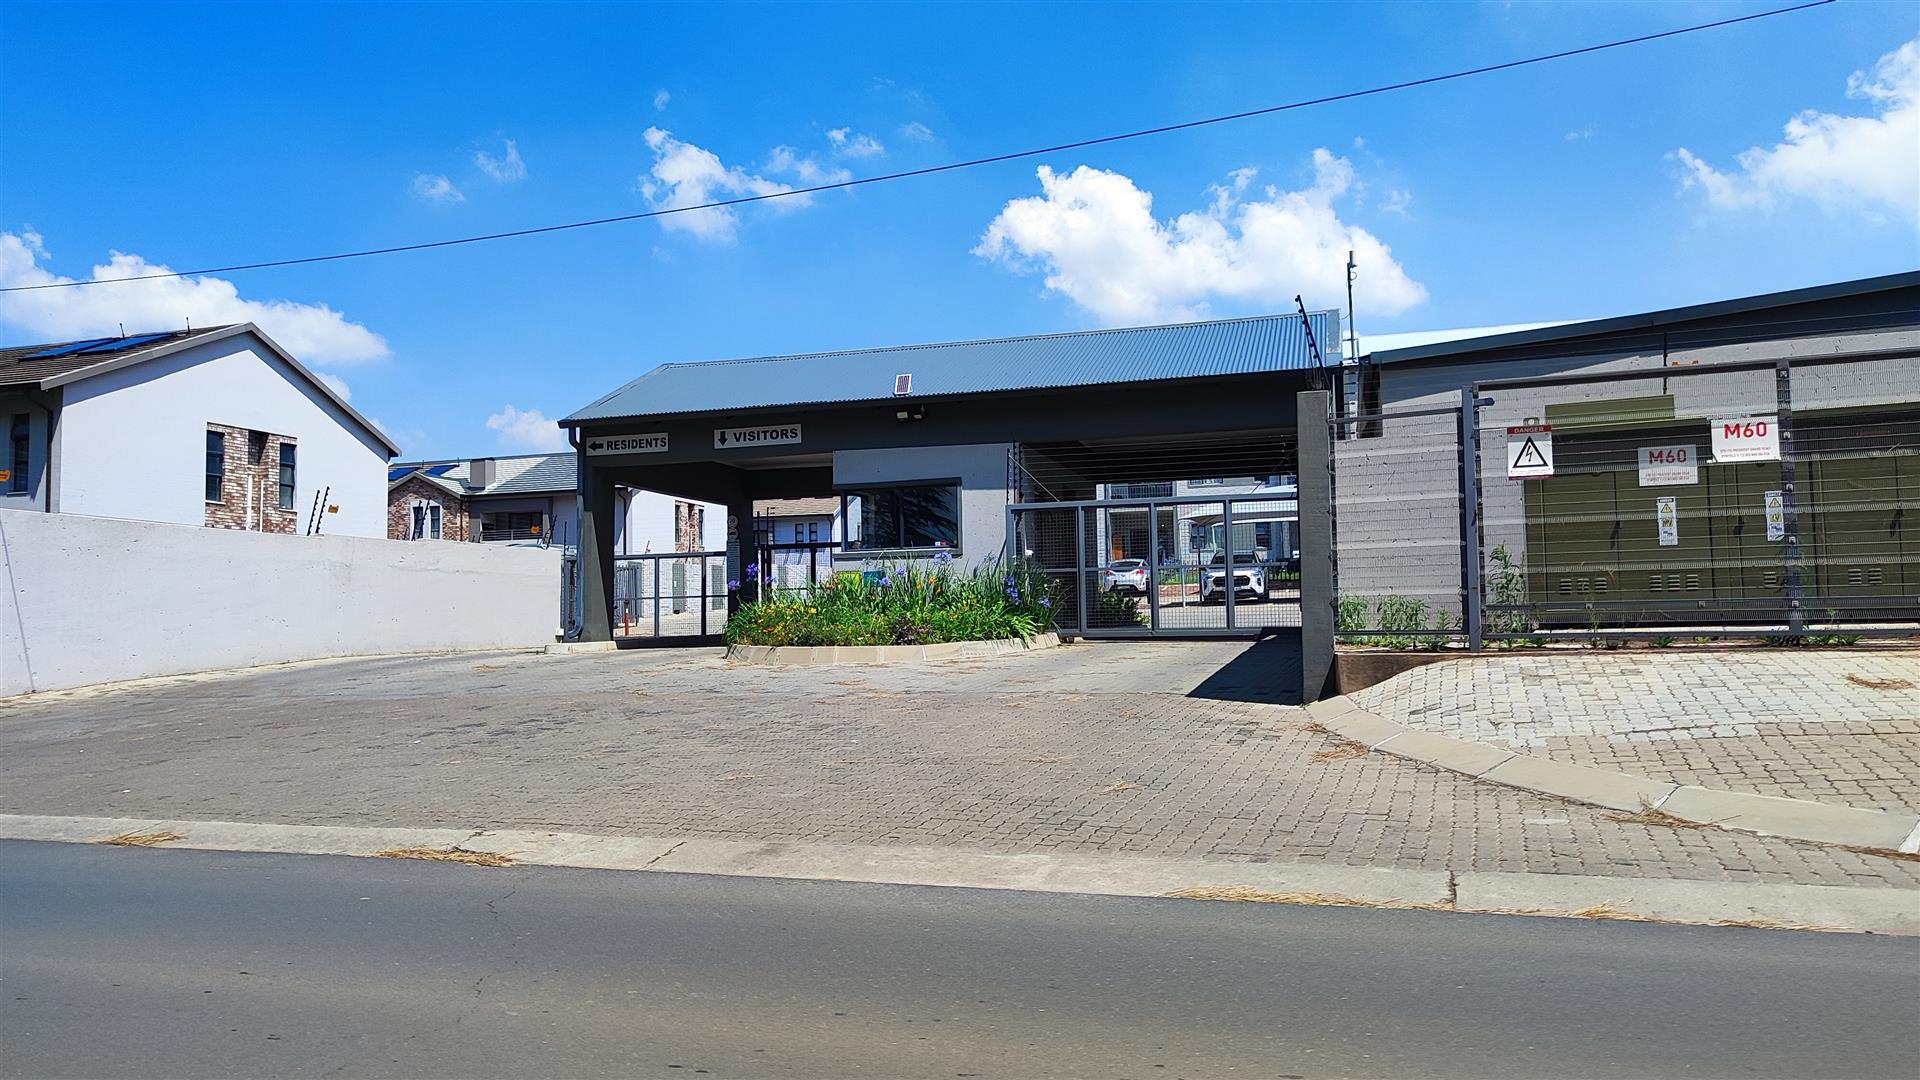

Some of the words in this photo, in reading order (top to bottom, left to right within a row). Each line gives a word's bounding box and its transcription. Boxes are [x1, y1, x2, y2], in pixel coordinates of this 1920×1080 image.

[733, 428, 798, 442] VISITORS
[1724, 421, 1767, 439] M60
[606, 437, 667, 451] RESIDENTS
[1648, 449, 1687, 464] M60
